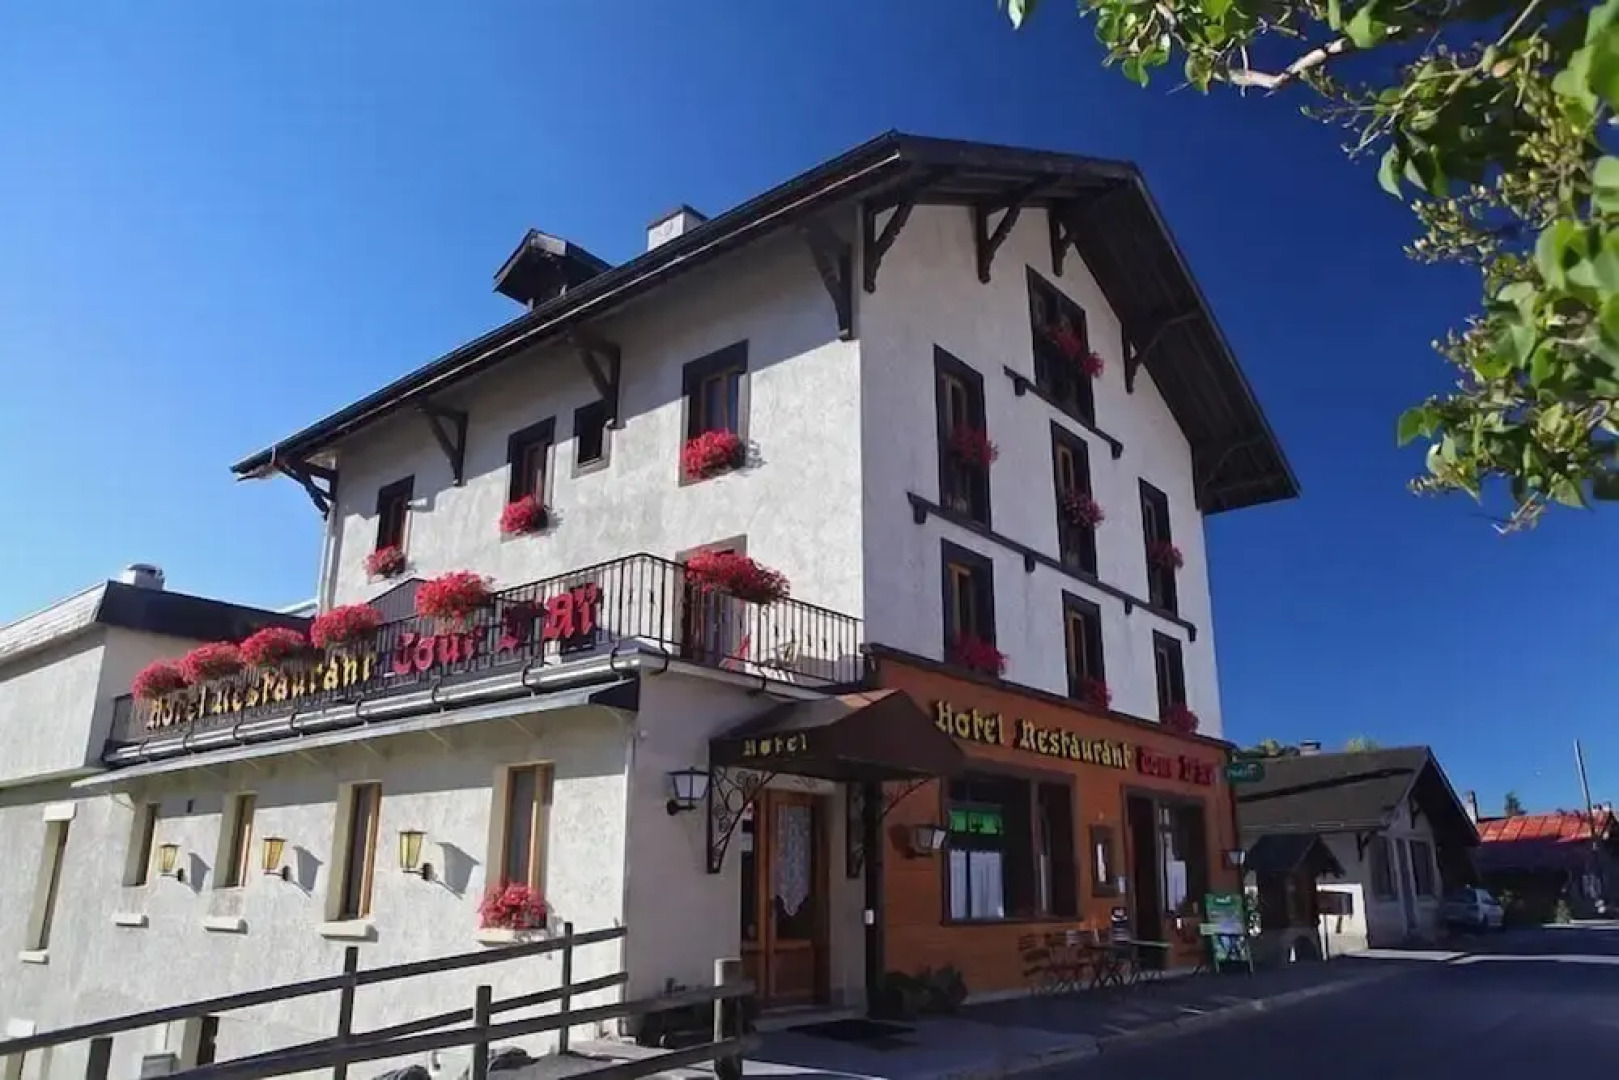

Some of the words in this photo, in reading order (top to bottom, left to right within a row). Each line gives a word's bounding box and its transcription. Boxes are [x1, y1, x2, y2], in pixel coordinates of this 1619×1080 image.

[743, 734, 808, 757] Hotel
[935, 700, 1005, 745] Hotel
[1018, 719, 1132, 770] Restaurant
